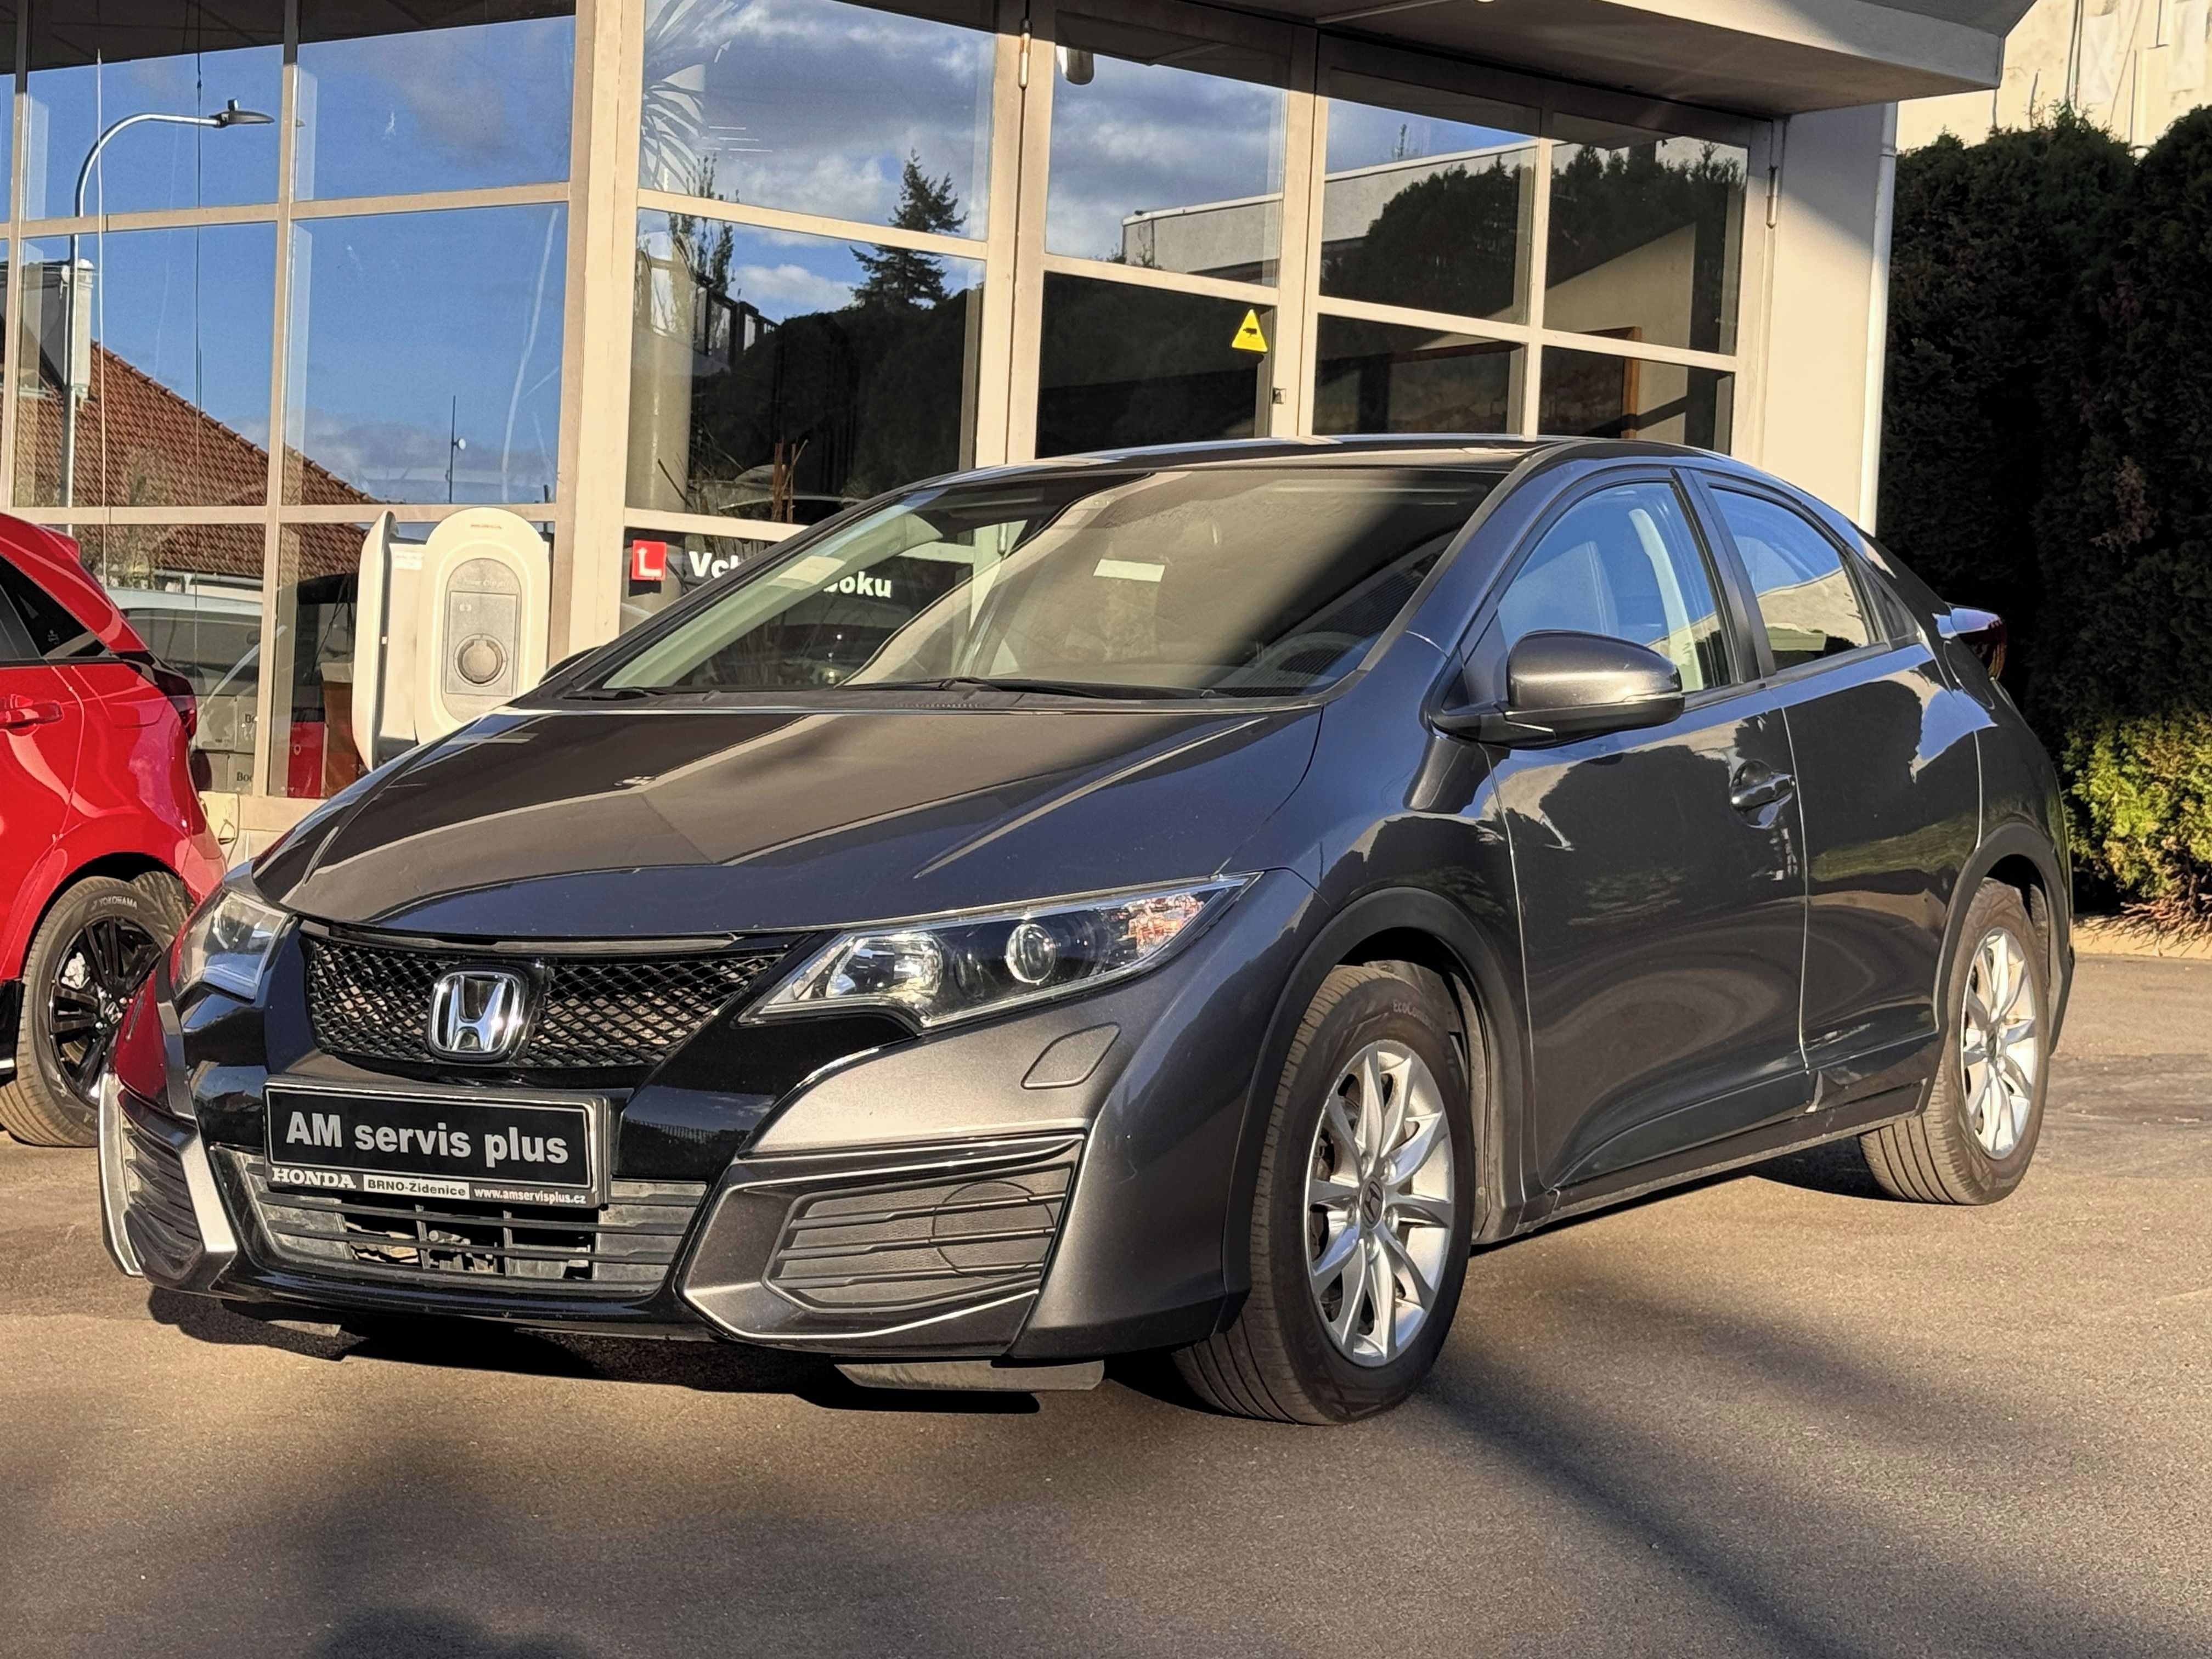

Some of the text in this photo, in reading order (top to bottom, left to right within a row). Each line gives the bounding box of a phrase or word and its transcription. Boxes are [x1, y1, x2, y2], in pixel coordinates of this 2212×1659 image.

[286, 1111, 568, 1168] AM servis plus
[272, 1167, 586, 1205] HONDA BRNO-Židenice www.amservisplus.cz
